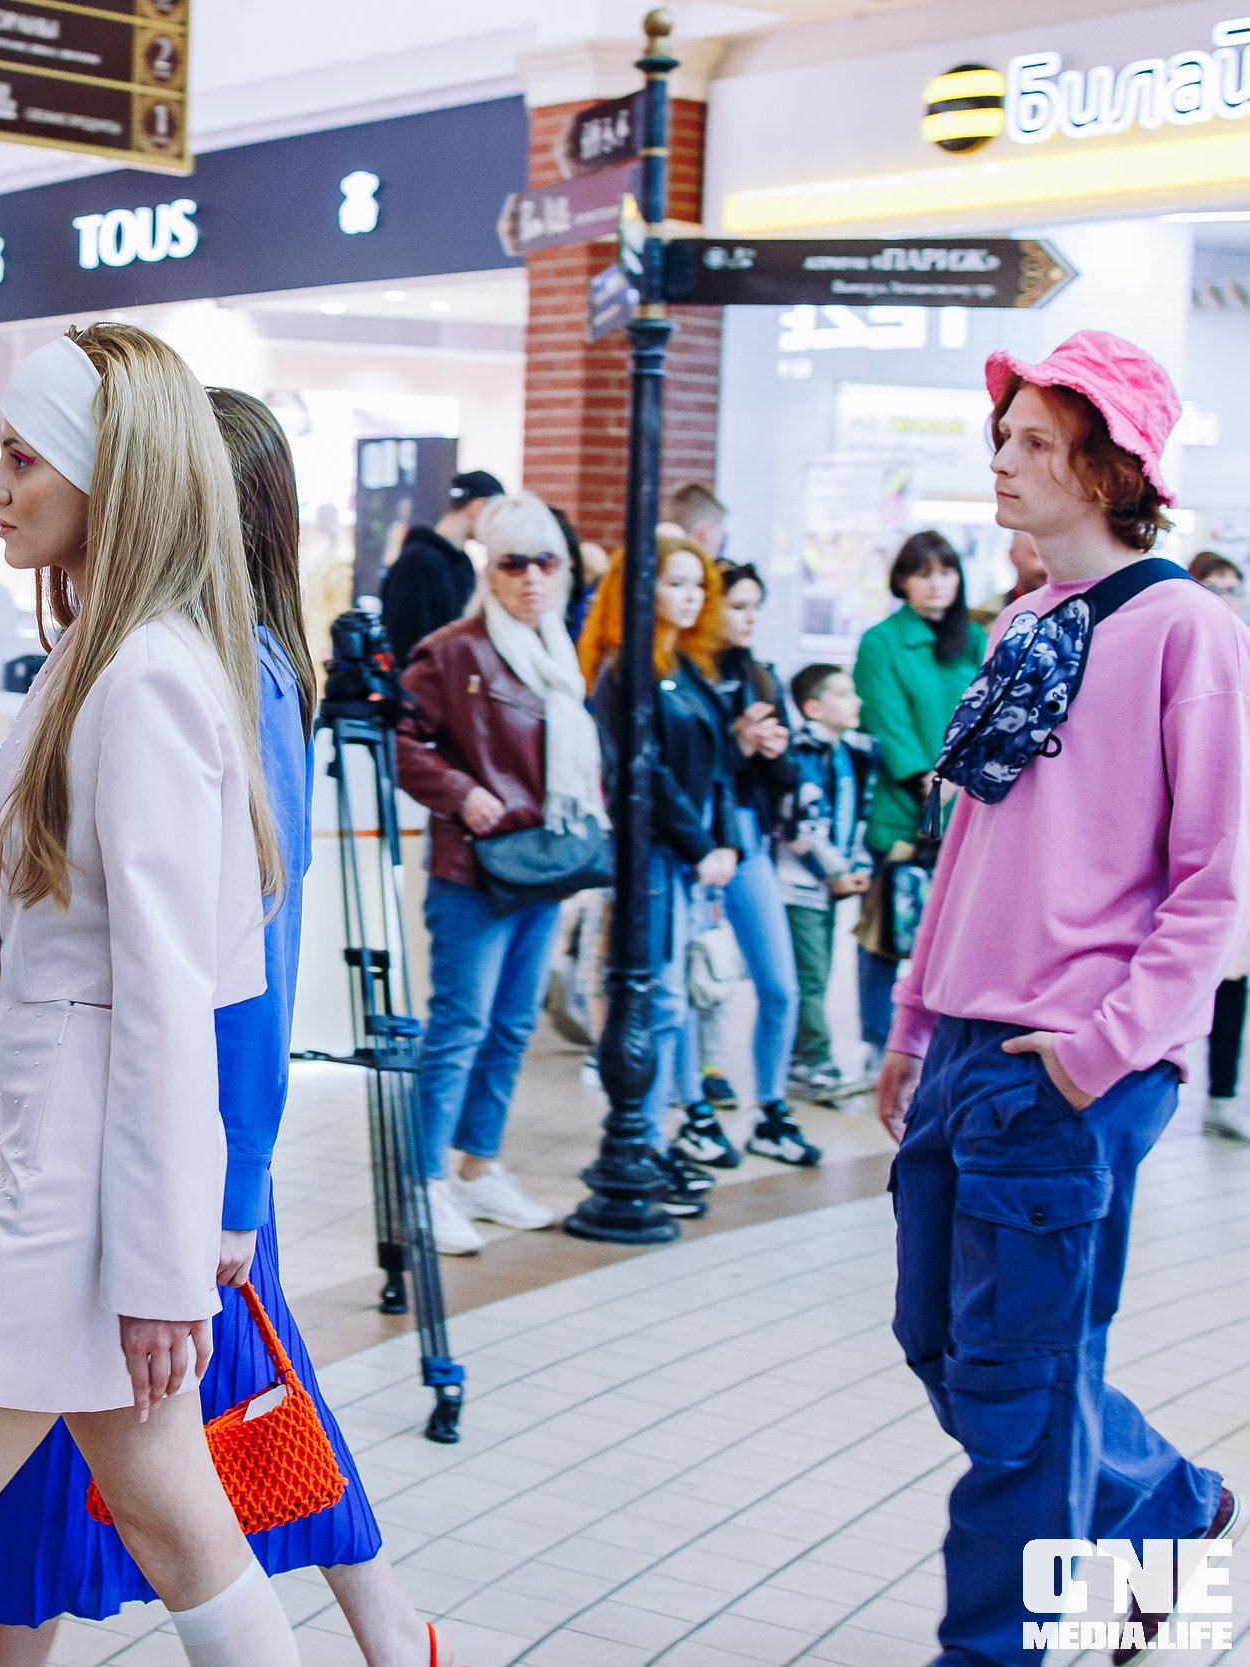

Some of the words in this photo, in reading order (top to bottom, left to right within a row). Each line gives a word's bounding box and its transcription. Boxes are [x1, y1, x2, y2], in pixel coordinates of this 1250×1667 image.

[153, 36, 172, 72] 2
[152, 103, 169, 137] 1
[73, 198, 199, 270] TOUS
